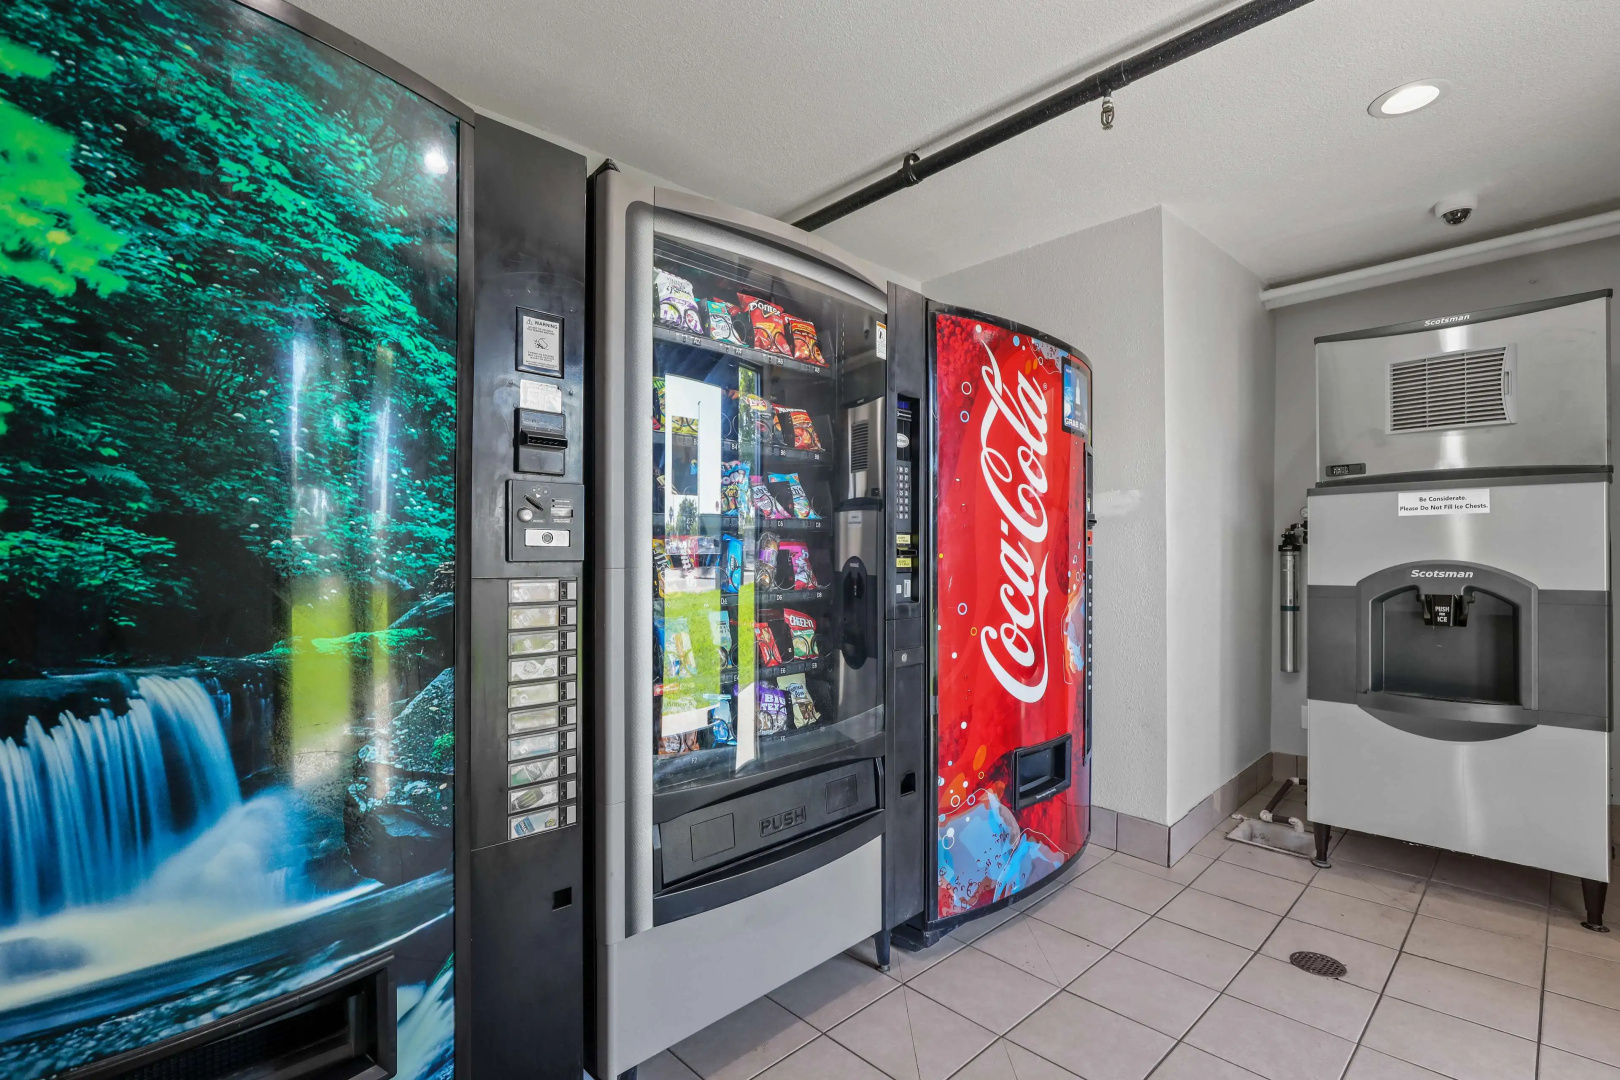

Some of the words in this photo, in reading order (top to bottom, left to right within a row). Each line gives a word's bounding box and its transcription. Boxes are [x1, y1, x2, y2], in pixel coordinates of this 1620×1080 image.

[534, 320, 559, 330] WARNING
[1424, 314, 1470, 327] Scotsman
[1064, 418, 1079, 430] GRAB
[980, 339, 1048, 703] Coca-Cola
[1411, 569, 1474, 578] Scotsman
[761, 808, 804, 835] PUSH
